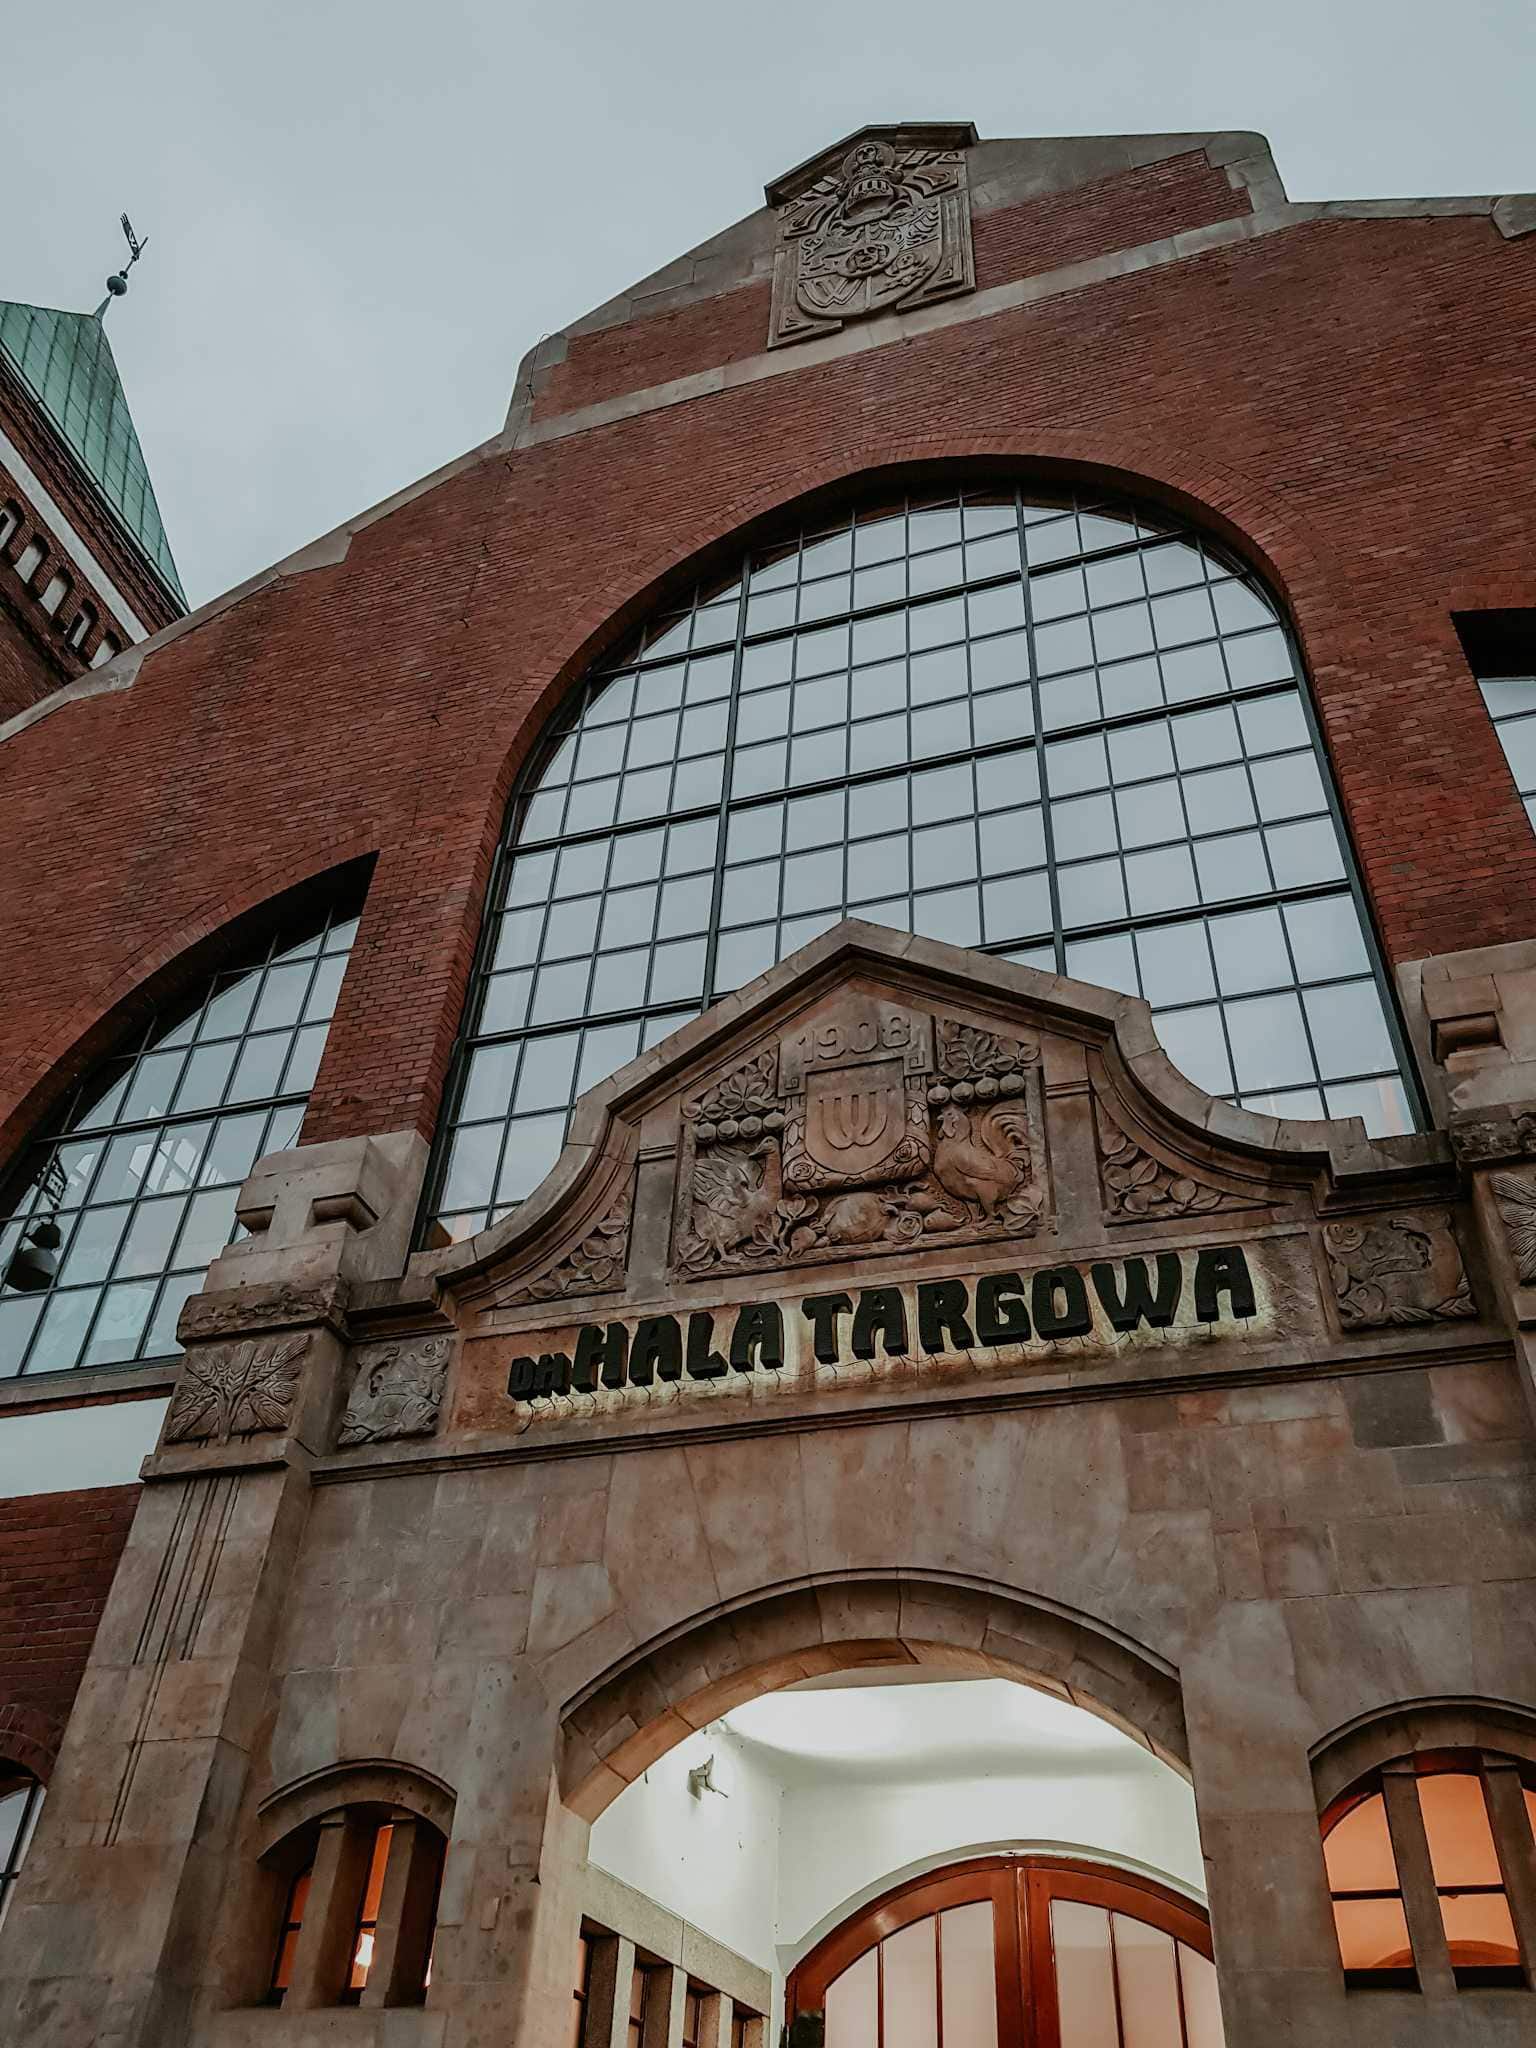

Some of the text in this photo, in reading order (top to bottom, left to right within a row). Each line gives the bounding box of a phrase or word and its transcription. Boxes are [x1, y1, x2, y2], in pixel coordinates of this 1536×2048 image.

[797, 1014, 911, 1064] 1908
[570, 1302, 785, 1394] HALA
[802, 1246, 1257, 1365] TARGOWA
